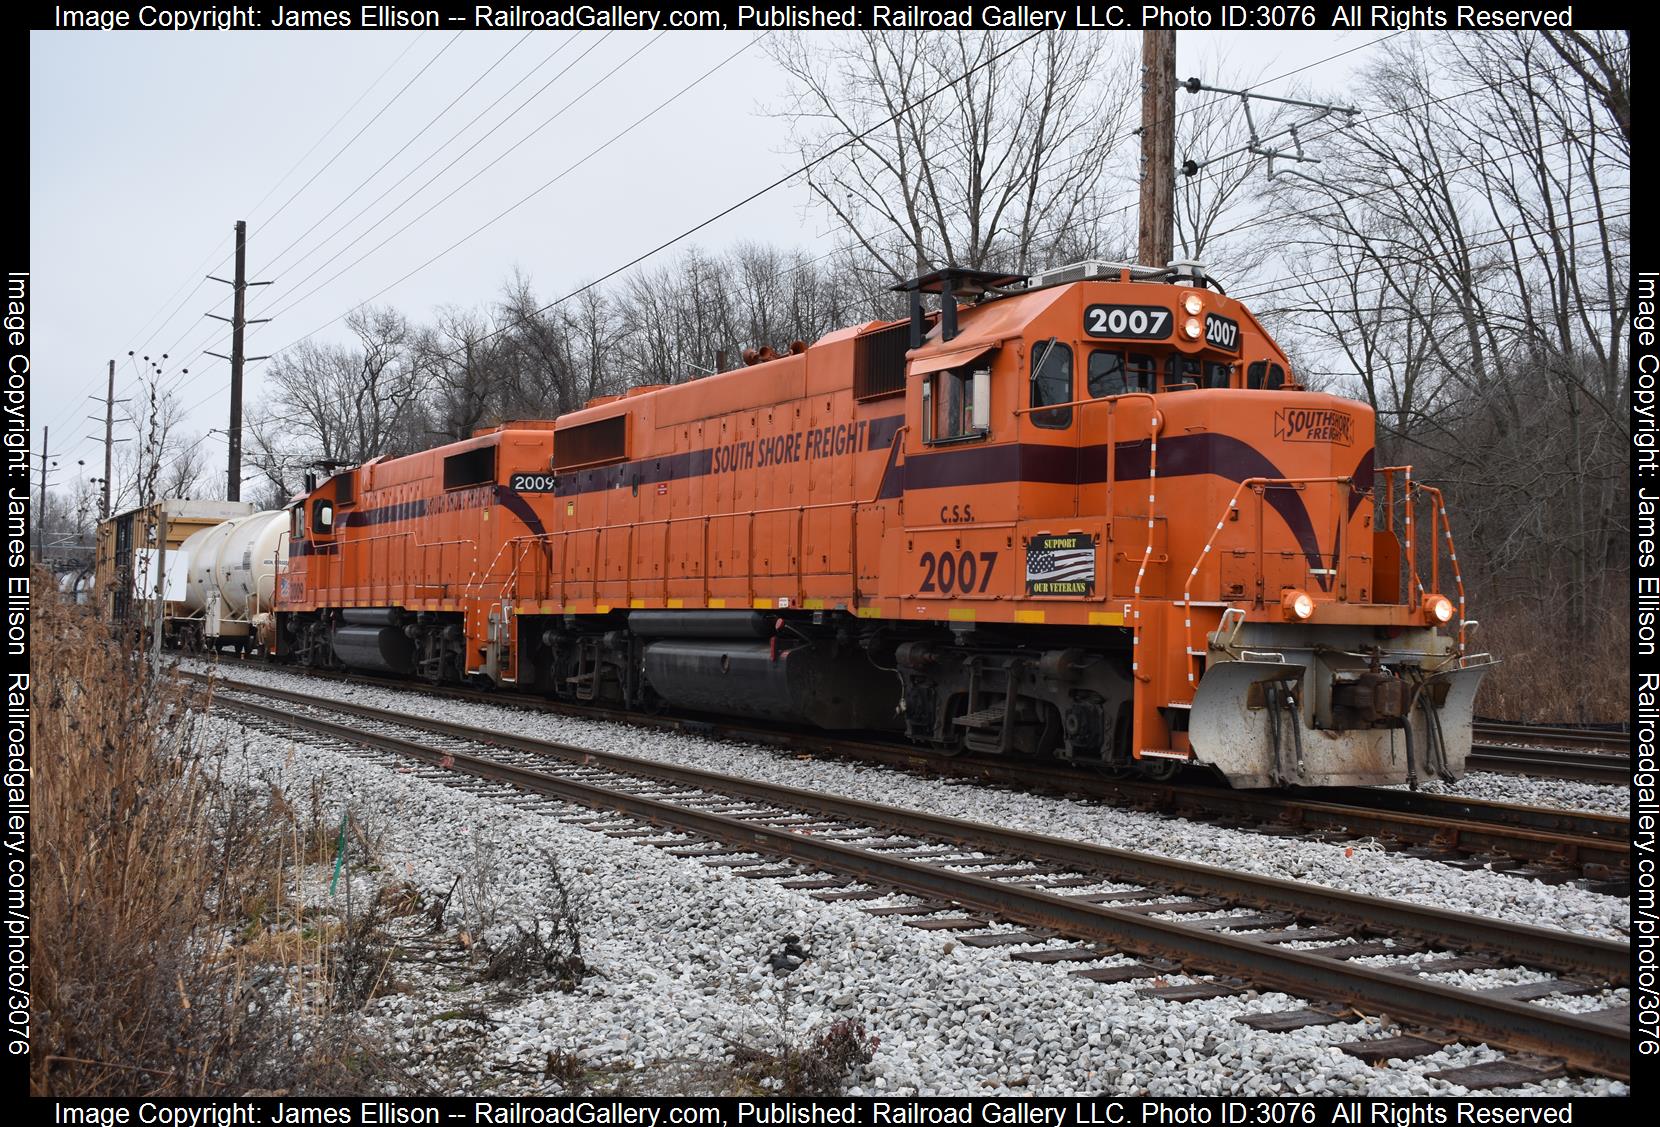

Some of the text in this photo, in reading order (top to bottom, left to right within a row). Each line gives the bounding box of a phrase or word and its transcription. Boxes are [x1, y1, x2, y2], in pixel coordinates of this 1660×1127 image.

[1089, 308, 1168, 334] 2007
[1206, 317, 1237, 346] 2007
[1287, 410, 1331, 437] SOUTH
[713, 420, 867, 474] SOUTH SHORE FREIGHT
[514, 475, 555, 490] 2009
[940, 504, 975, 523] C.S.S.
[1044, 538, 1077, 549] SUPPORT
[919, 550, 998, 594] 2007
[1033, 582, 1087, 593] OUR VETERANS
[1123, 603, 1132, 618] F
